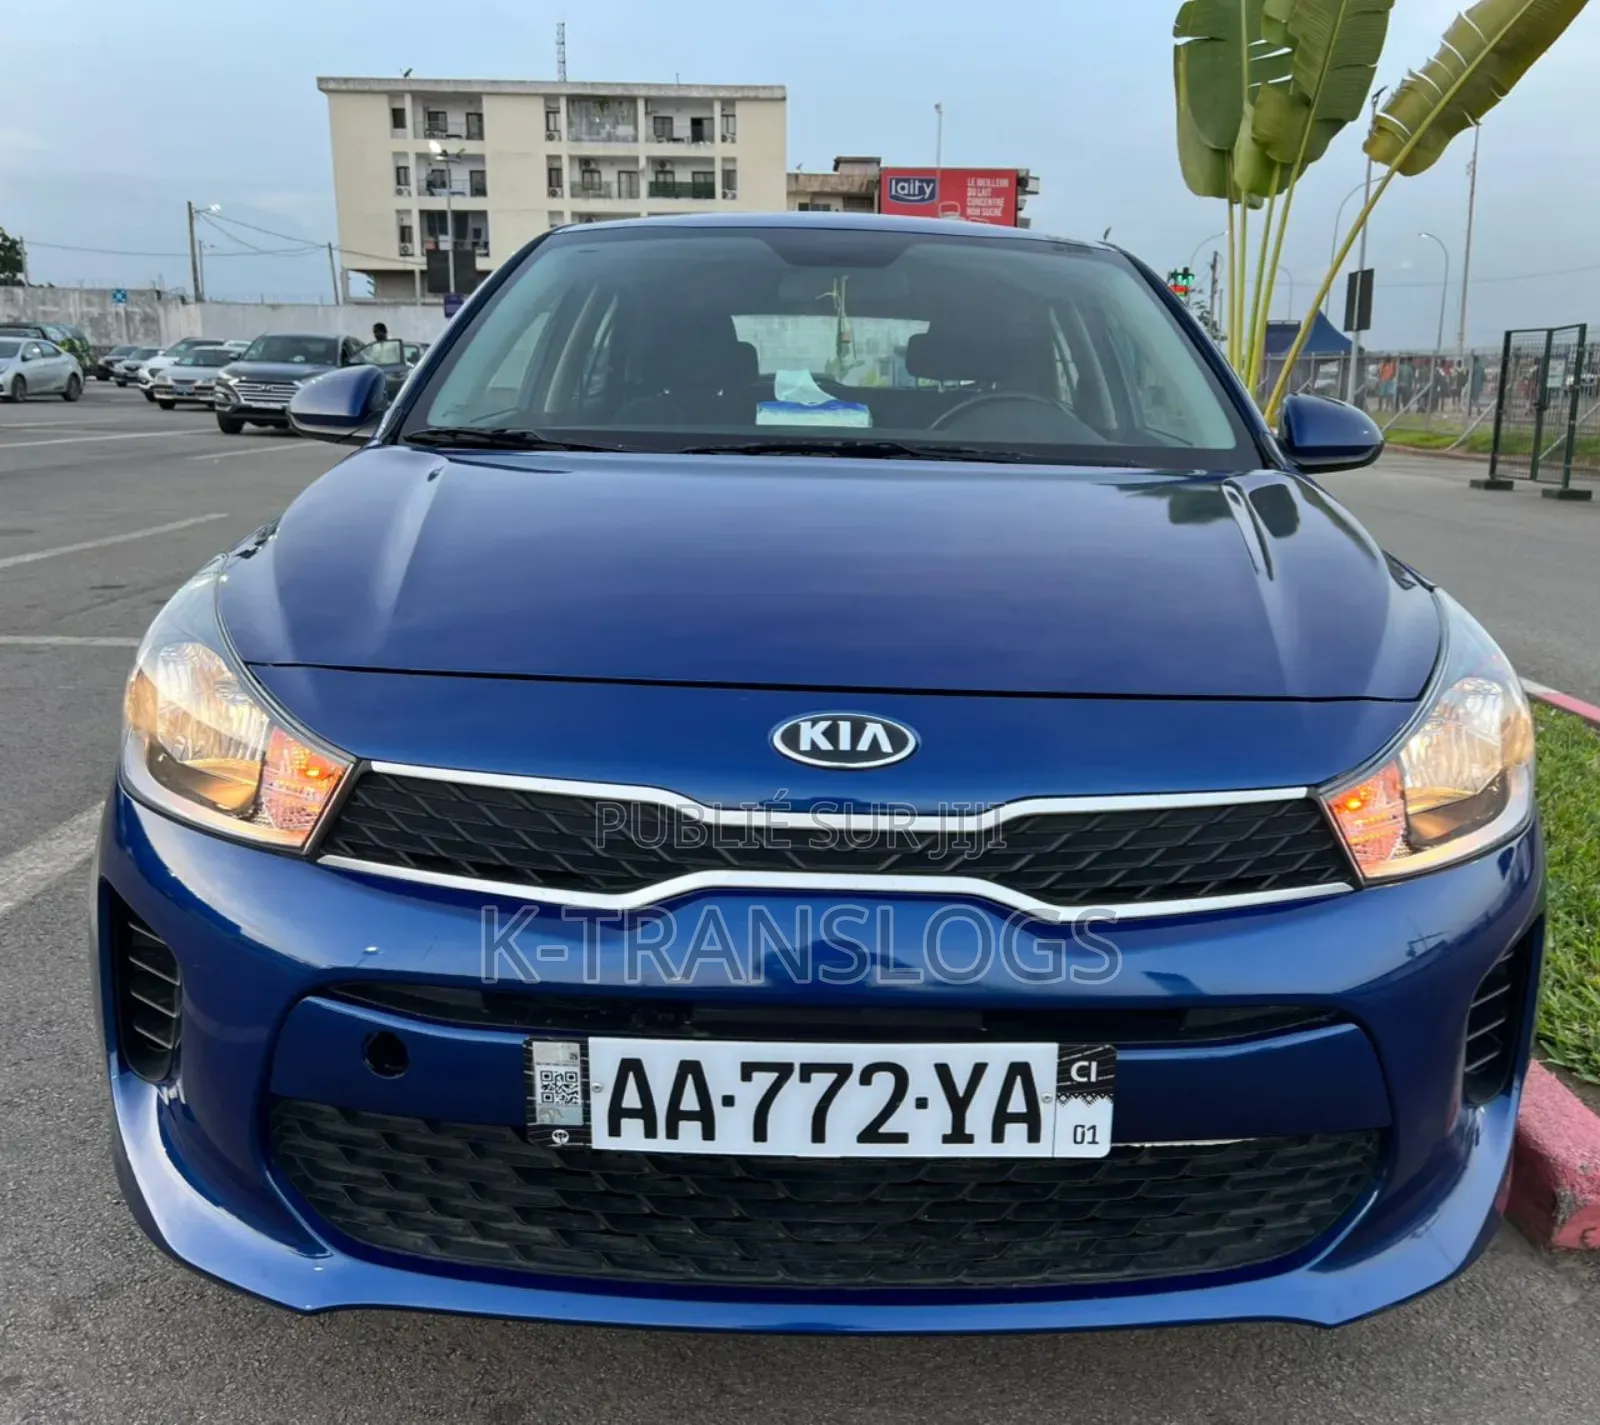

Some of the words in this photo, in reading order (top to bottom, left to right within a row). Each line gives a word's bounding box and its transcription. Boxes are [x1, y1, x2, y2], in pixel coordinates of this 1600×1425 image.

[798, 720, 893, 753] KIA
[1070, 1061, 1097, 1082] CI
[1073, 1124, 1099, 1145] 01
